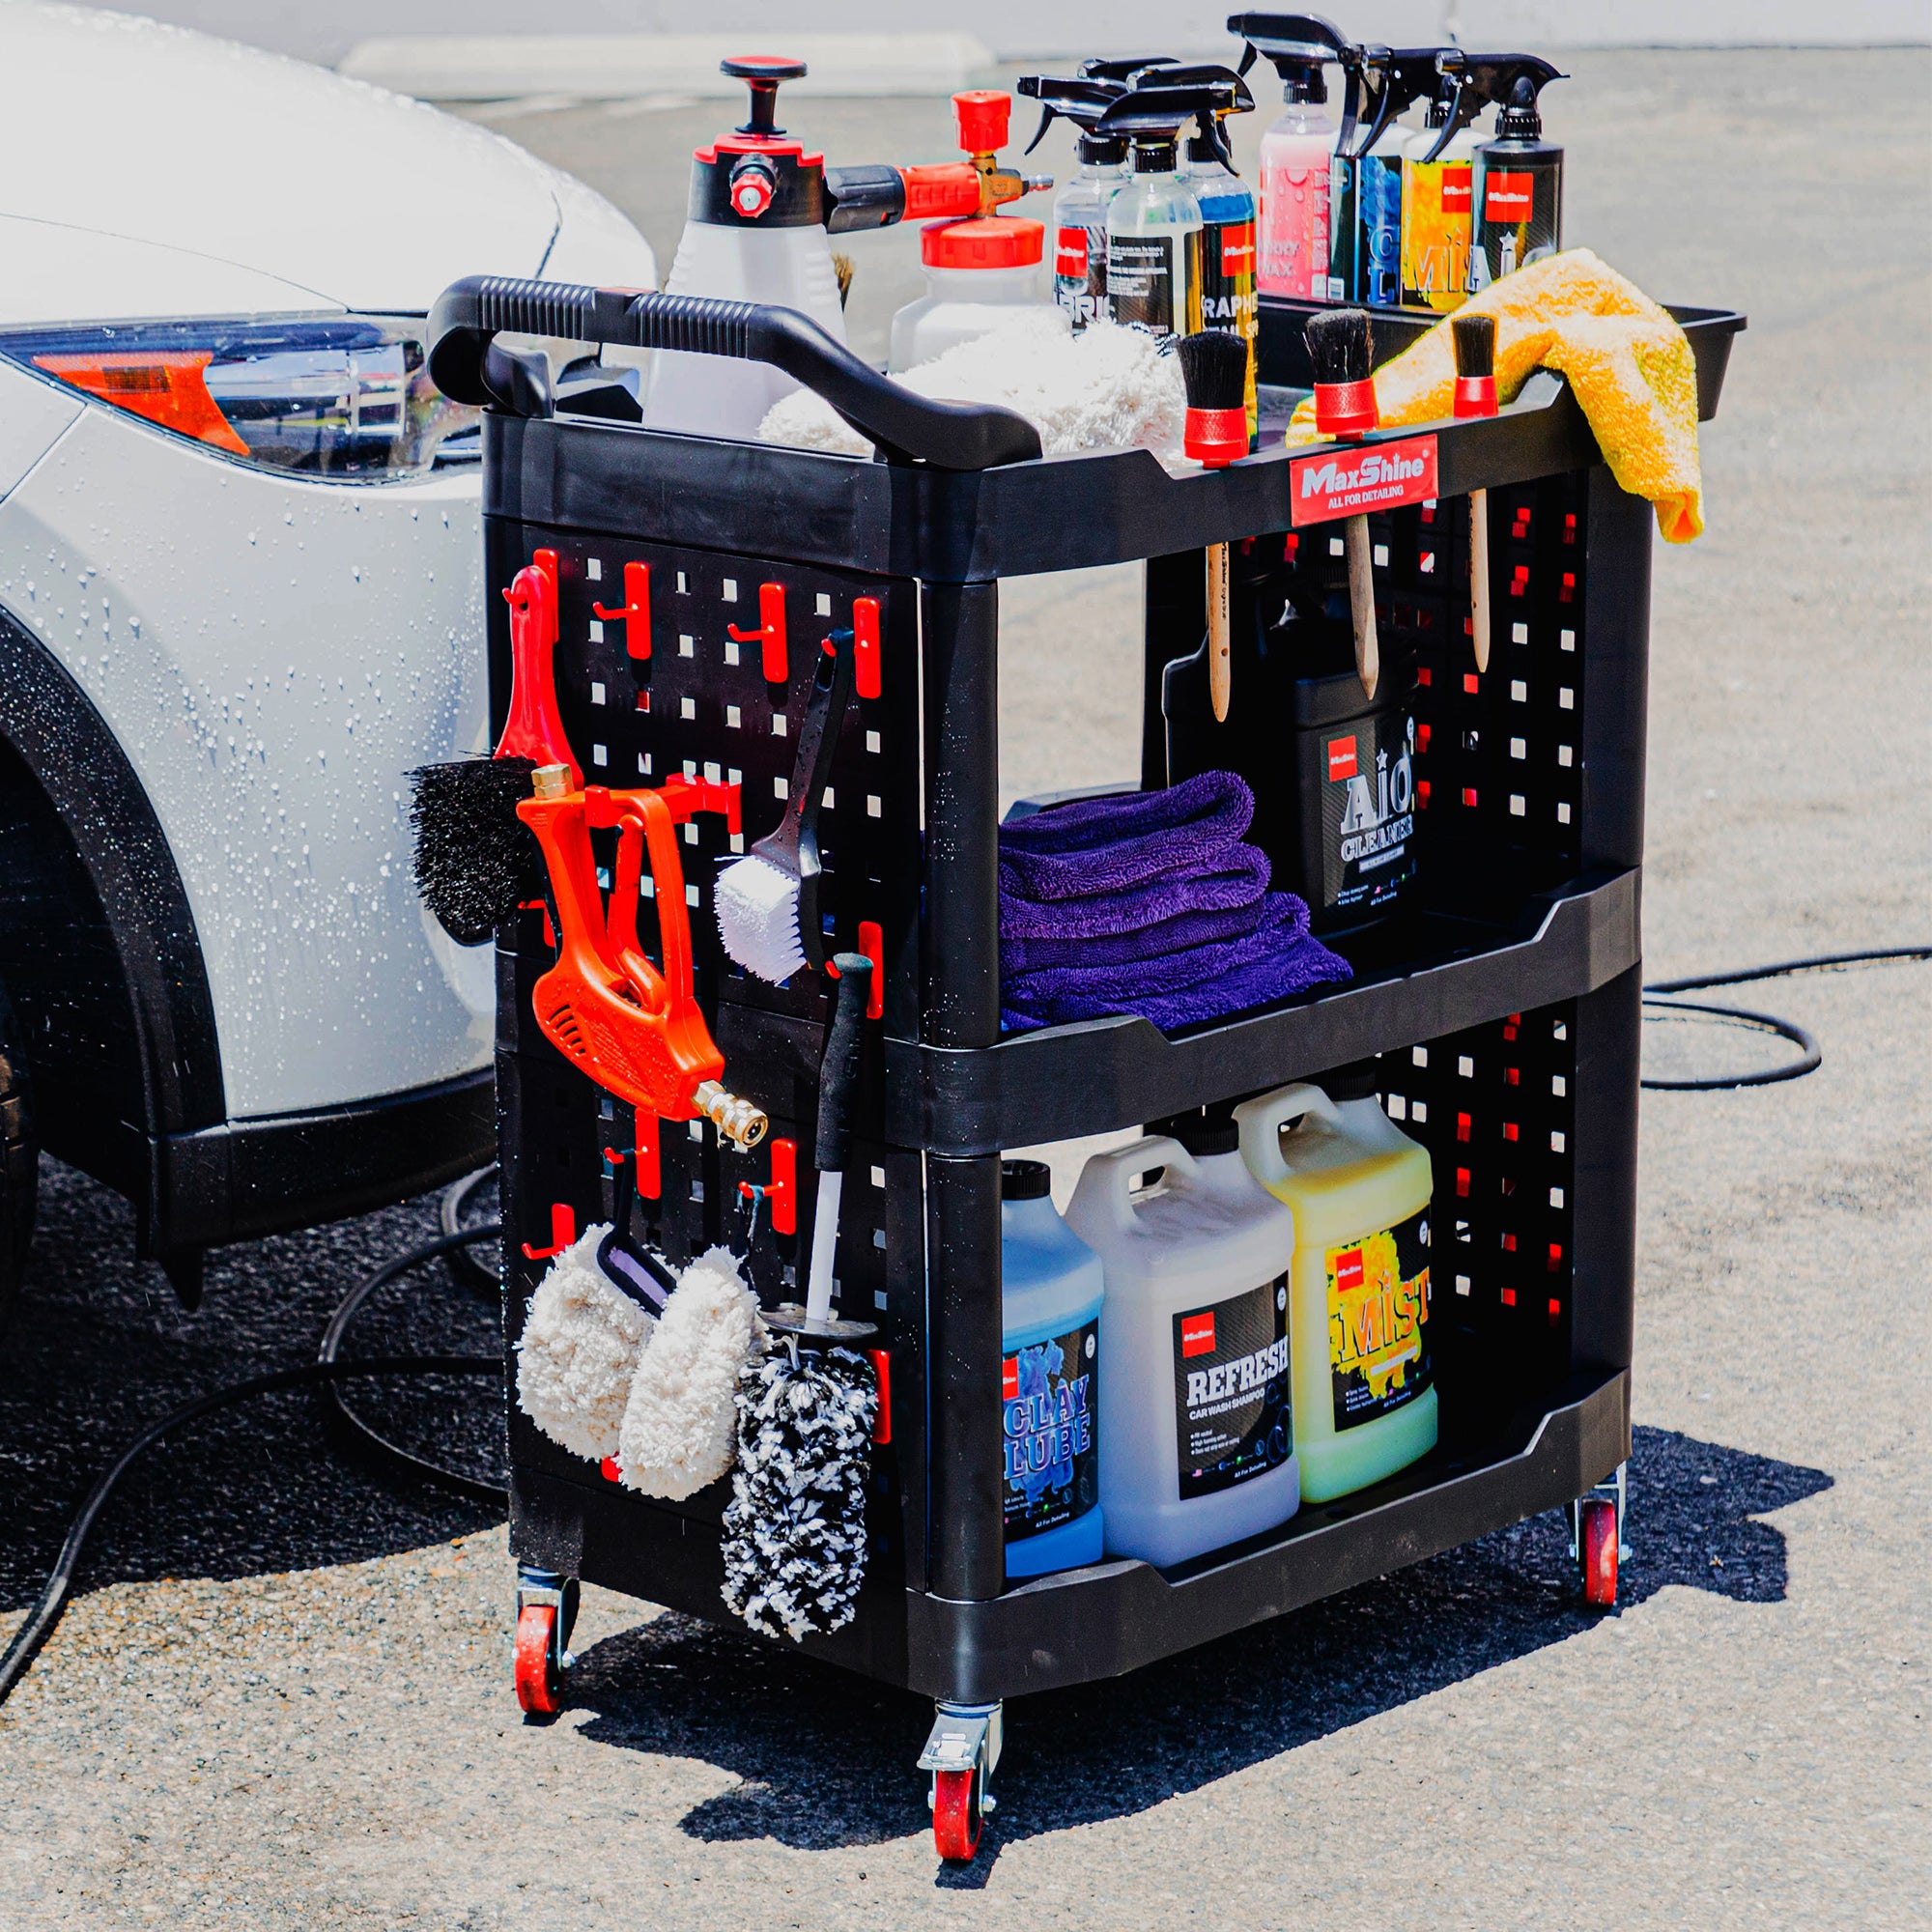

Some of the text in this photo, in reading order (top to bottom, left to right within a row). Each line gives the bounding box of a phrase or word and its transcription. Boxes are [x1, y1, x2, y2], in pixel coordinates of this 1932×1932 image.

[1301, 452, 1425, 498] MaxShine
[1328, 484, 1404, 509] ALL FOR DETAILING
[1341, 814, 1413, 863] CLEANER
[1186, 1334, 1290, 1407] REFRESH
[1003, 1374, 1090, 1437] CLAY
[1189, 1388, 1265, 1421] CAR WASH SHAMPOO
[1003, 1412, 1091, 1481] LUBE
